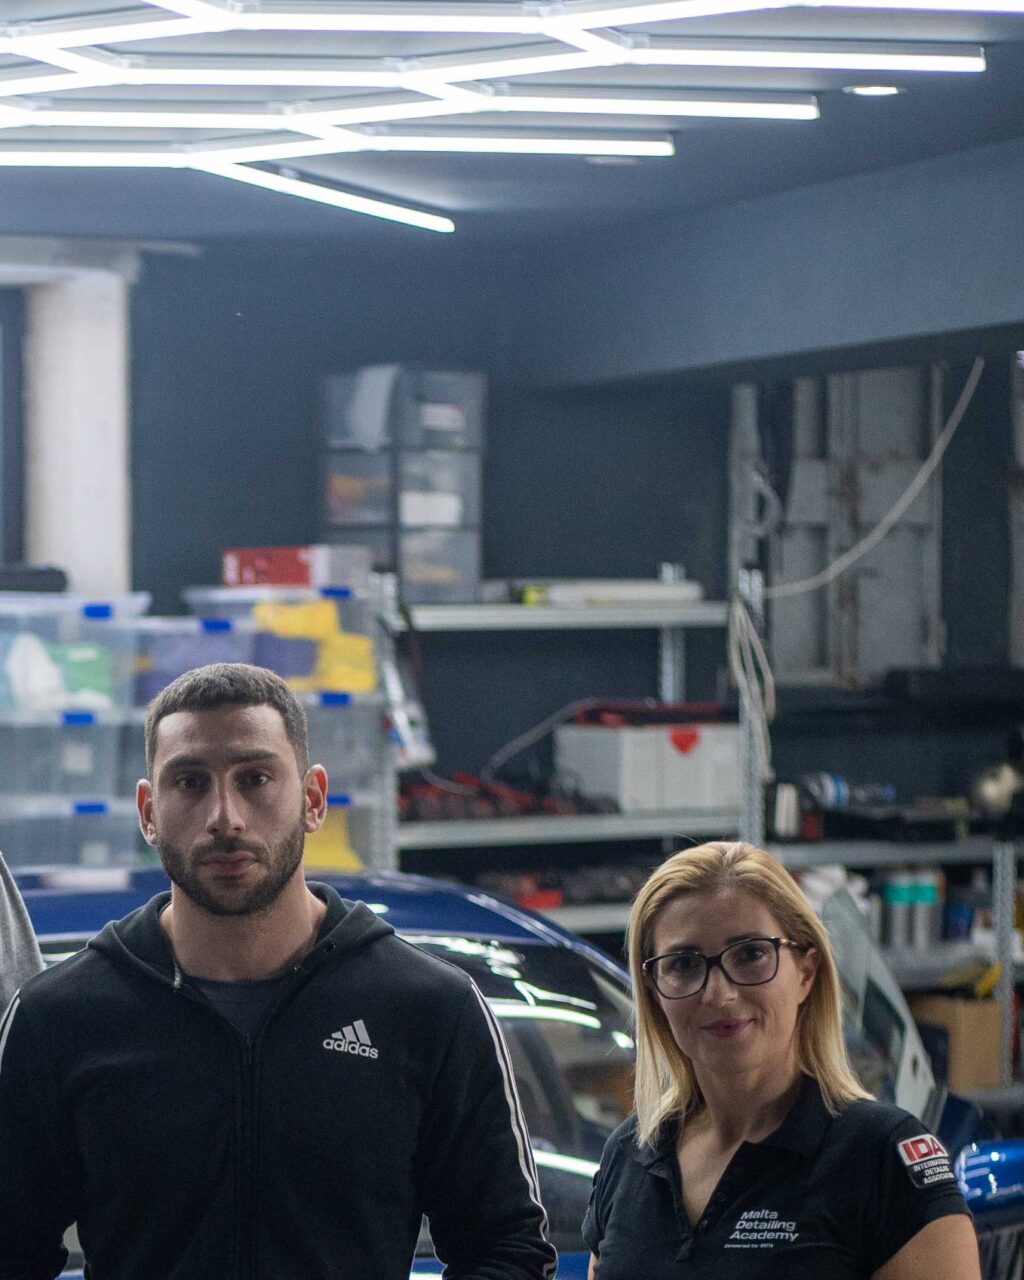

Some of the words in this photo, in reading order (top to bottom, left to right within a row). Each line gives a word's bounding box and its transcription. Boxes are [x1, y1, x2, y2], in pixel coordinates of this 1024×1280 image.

[322, 1038, 379, 1060] adidas
[902, 1137, 945, 1163] IDA
[740, 1209, 778, 1220] Malta
[735, 1220, 796, 1232] Detailing
[729, 1230, 799, 1242] Academy
